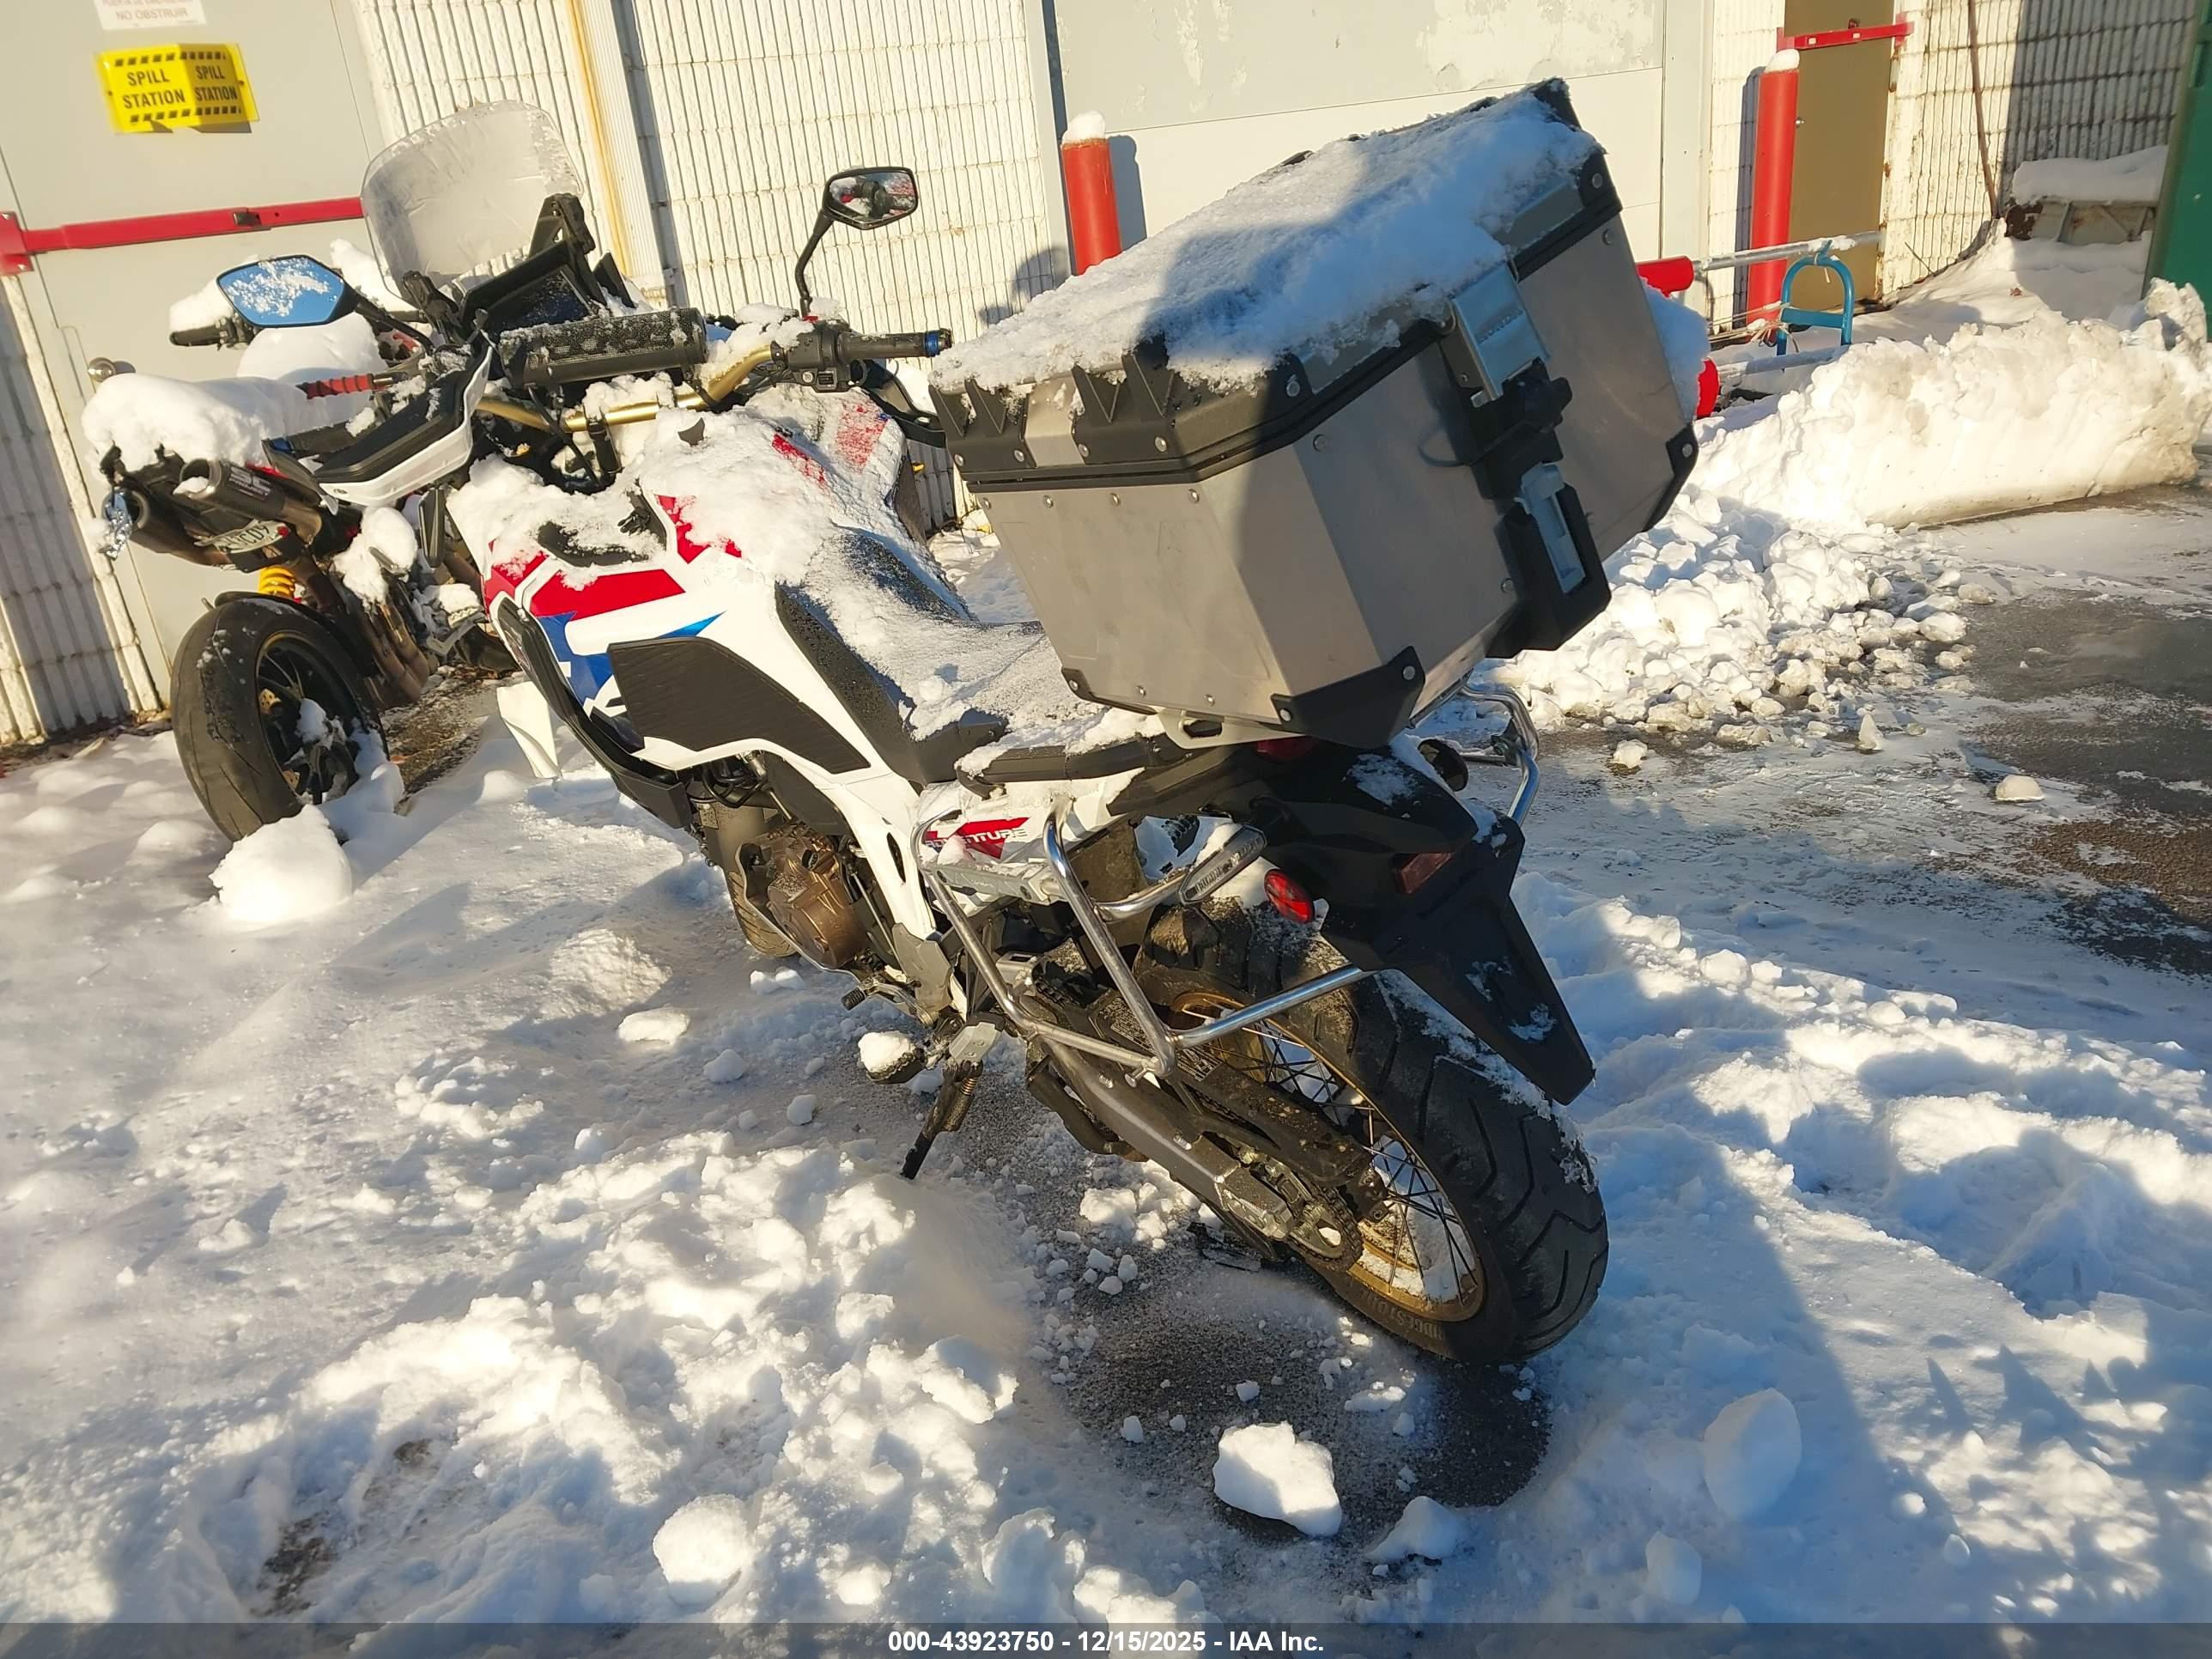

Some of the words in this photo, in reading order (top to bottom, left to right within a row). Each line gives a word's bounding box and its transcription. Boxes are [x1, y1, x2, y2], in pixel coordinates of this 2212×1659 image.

[116, 10, 132, 21] NO
[127, 69, 170, 86] SPILL
[195, 65, 225, 80] SPILL
[122, 88, 185, 109] STATION
[194, 86, 238, 101] STATION
